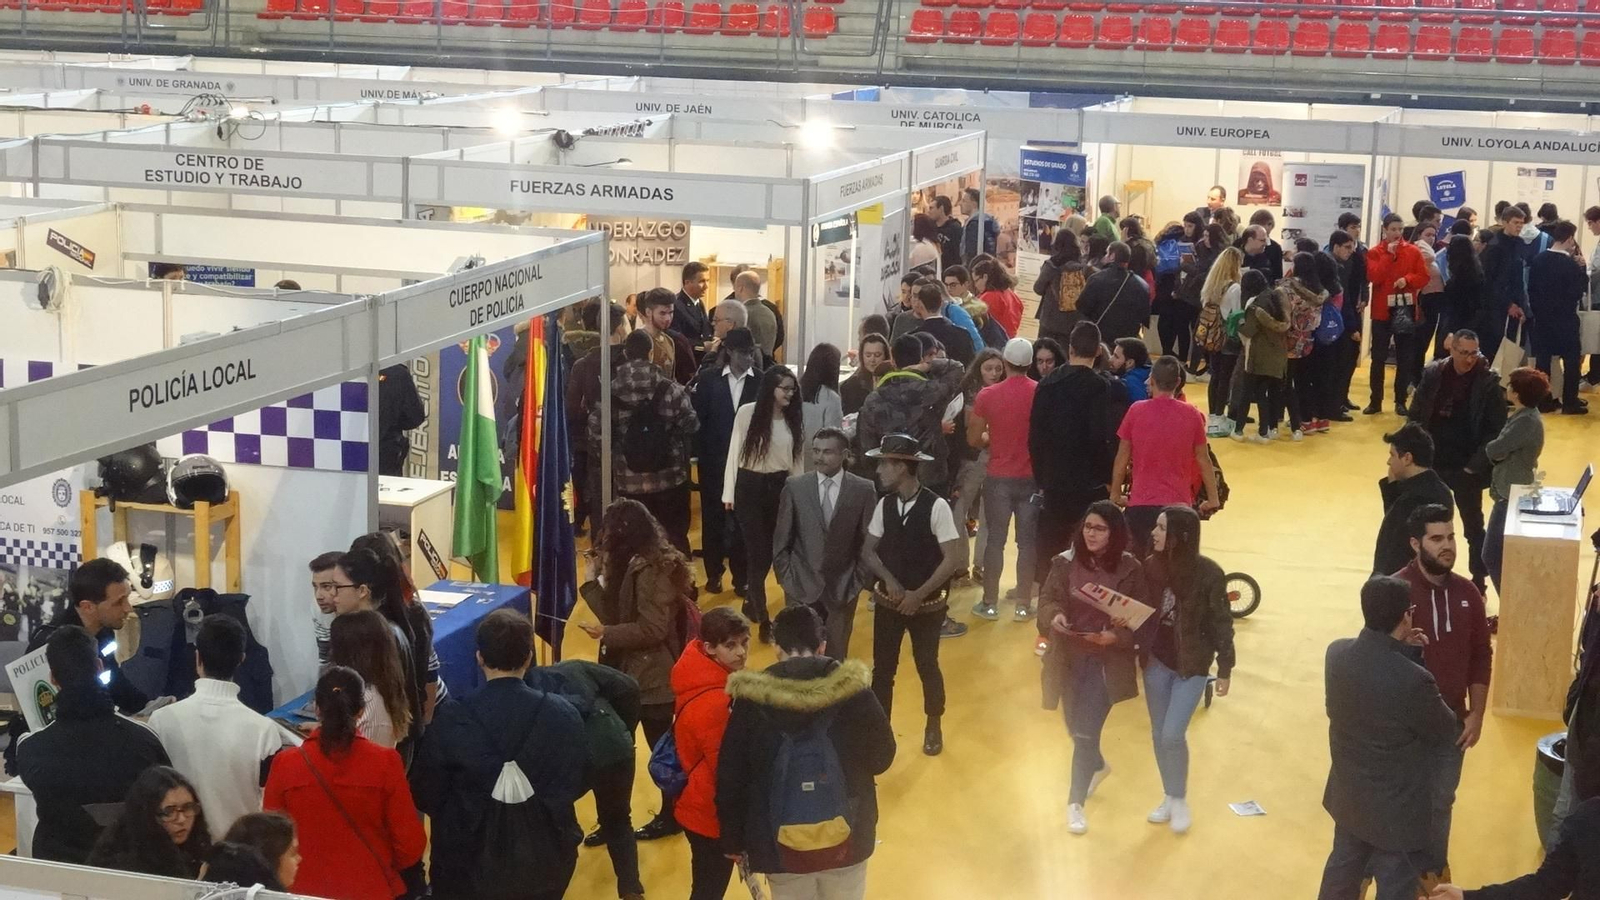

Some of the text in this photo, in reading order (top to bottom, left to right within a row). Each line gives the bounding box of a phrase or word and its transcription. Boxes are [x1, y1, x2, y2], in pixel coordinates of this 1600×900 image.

[129, 77, 221, 90] UNIV. DE GRANADA
[635, 102, 712, 114] UNIV. DE JAÉN
[891, 109, 981, 122] UNIV. CATOLICA
[1176, 126, 1270, 139] UNIV. EUROPEA
[1441, 136, 1473, 147] UNIV.
[1477, 138, 1530, 150] LOYOLA
[175, 153, 264, 171] CENTRO DE
[145, 169, 302, 189] ESTUDIO Y TRABAJO
[510, 179, 674, 201] FUERZAS ARMADAS
[839, 180, 862, 198] FUERZAS
[200, 272, 252, 282] compatibilizar
[449, 263, 543, 308] CUERPO NACIONAL
[470, 291, 524, 327] DE POLICÍA
[129, 358, 256, 413] POLICÍA LOCAL
[13, 522, 25, 532] DE
[27, 523, 35, 533] TI
[42, 527, 55, 535] 957
